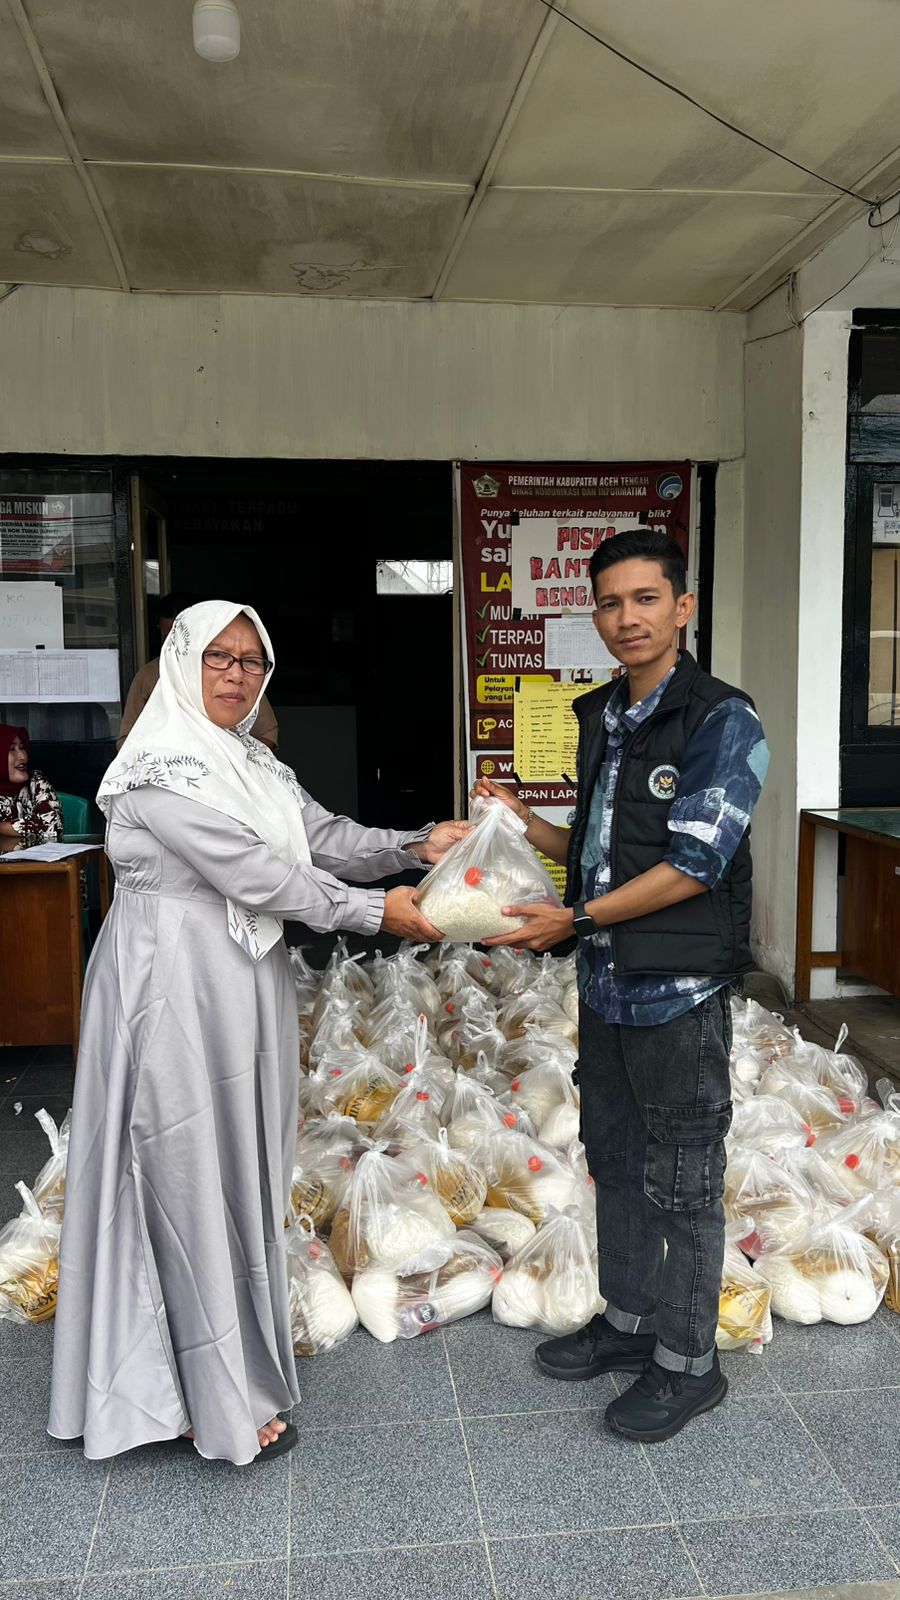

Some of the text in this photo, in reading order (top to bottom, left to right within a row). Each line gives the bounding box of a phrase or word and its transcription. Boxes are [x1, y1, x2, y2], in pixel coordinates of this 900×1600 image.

[508, 475, 649, 487] PEMERINTAH KABUPATEN ACEH TENGAH
[511, 487, 647, 496] DINAS KOMUNIKASI DAN INFORMATIKA
[14, 501, 49, 515] MISKIN
[480, 509, 510, 520] Punya
[552, 509, 585, 518] terkait
[586, 509, 634, 520] pelayanan
[490, 653, 543, 669] TUNTAS
[517, 789, 549, 799] SP4N
